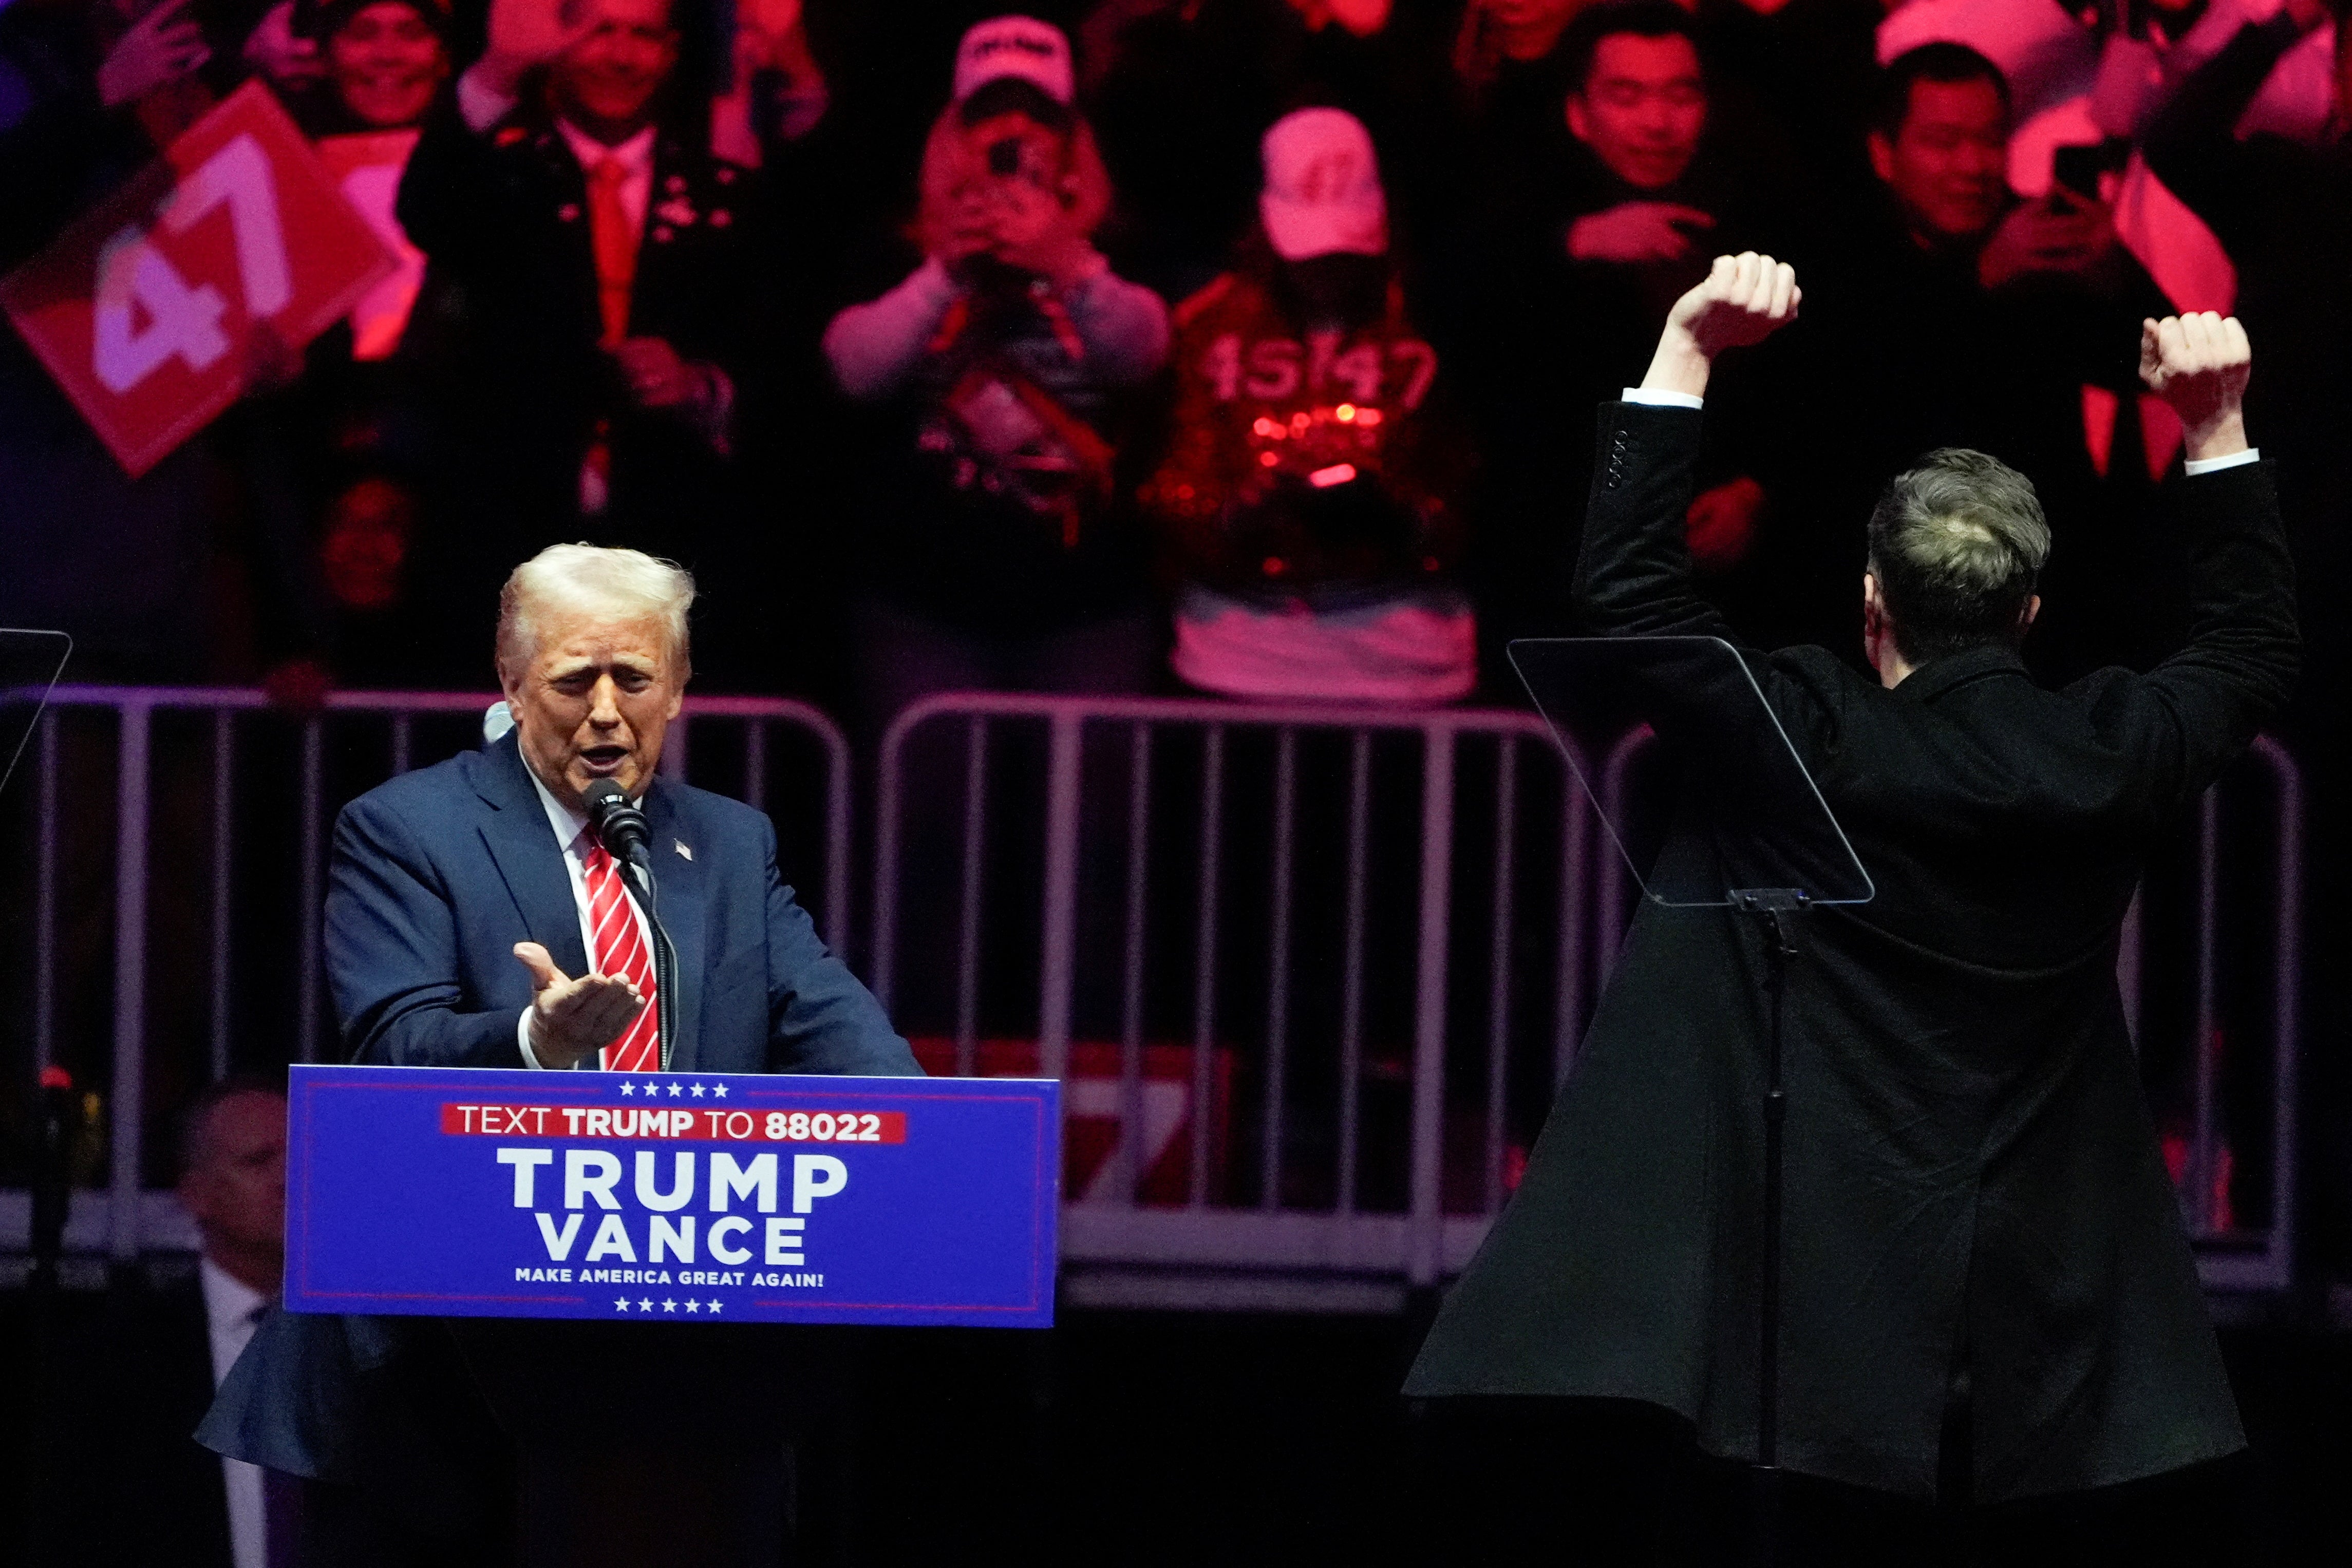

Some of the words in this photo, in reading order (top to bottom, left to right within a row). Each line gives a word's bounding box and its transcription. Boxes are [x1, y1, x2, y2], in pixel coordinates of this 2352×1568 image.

[92, 131, 294, 396] 47
[457, 1106, 551, 1134] TEXT
[562, 1108, 694, 1137] TRUMP
[704, 1111, 754, 1139] TO
[765, 1112, 880, 1141] 88022
[496, 1147, 848, 1214] TRUMP
[534, 1213, 805, 1265] VANCE
[515, 1268, 572, 1282] MAKE
[579, 1269, 671, 1284] AMERICA
[678, 1271, 745, 1286] GREAT
[751, 1273, 824, 1287] AGAIN!
